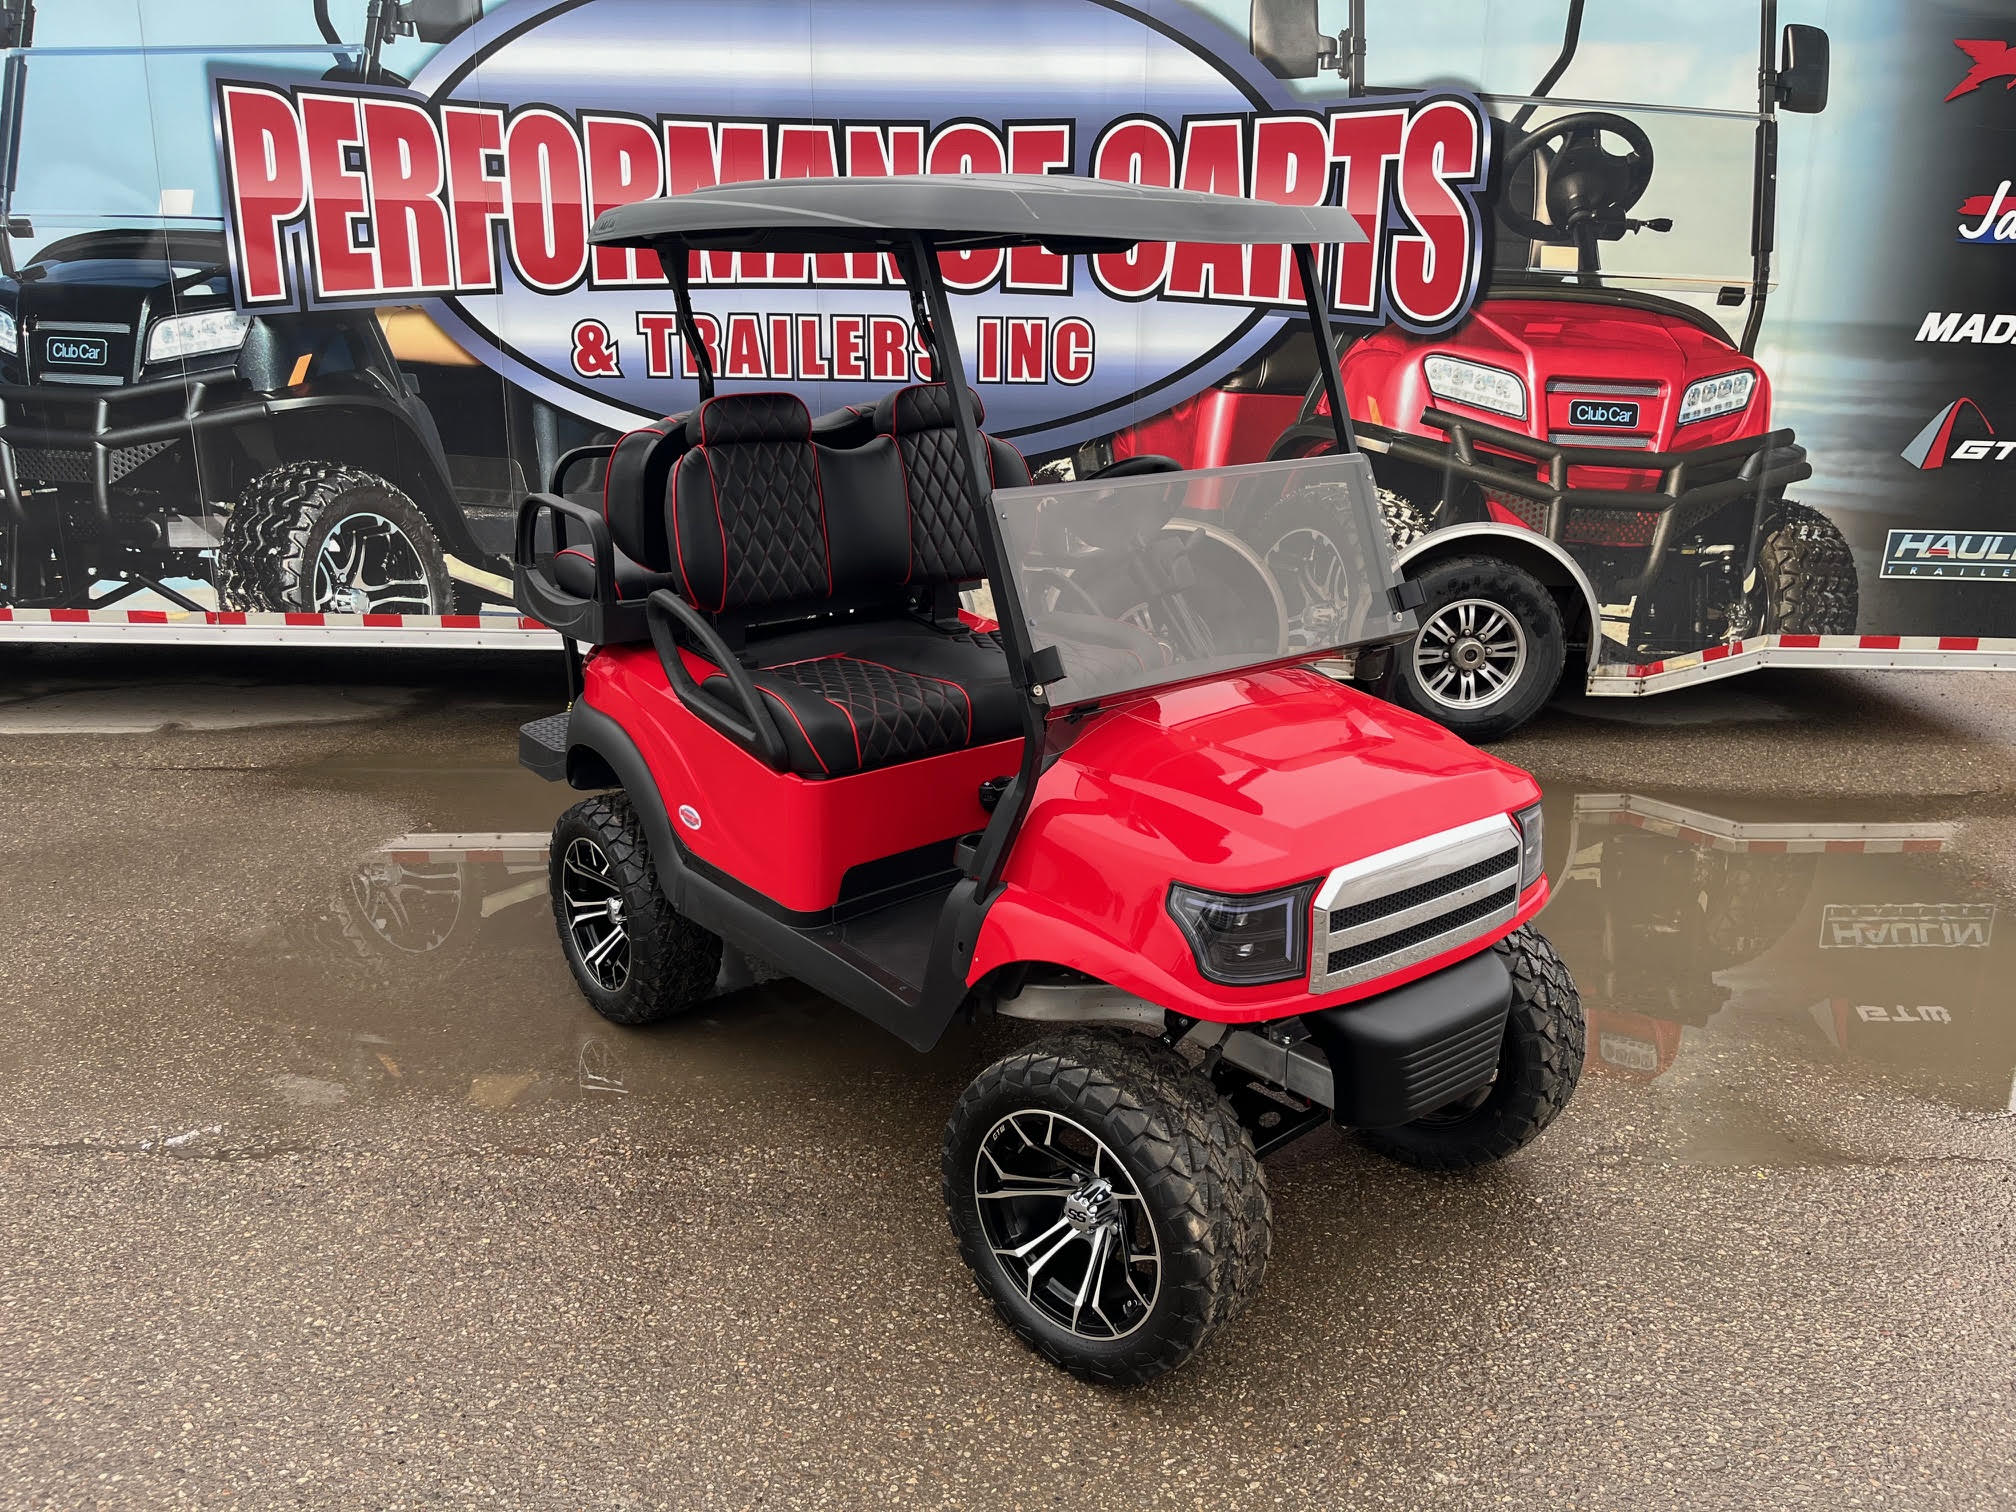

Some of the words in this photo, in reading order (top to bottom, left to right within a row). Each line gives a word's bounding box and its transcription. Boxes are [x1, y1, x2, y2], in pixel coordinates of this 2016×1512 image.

[1092, 99, 1480, 322] CARTS
[1914, 312, 2016, 345] MAD
[53, 343, 78, 358] Club
[79, 344, 100, 359] Car
[572, 319, 623, 378] &
[978, 316, 1096, 386] INC
[1577, 405, 1607, 421] Club
[1608, 406, 1632, 422] Car
[1894, 534, 2016, 561] HAUL
[1067, 1207, 1088, 1223] SS
